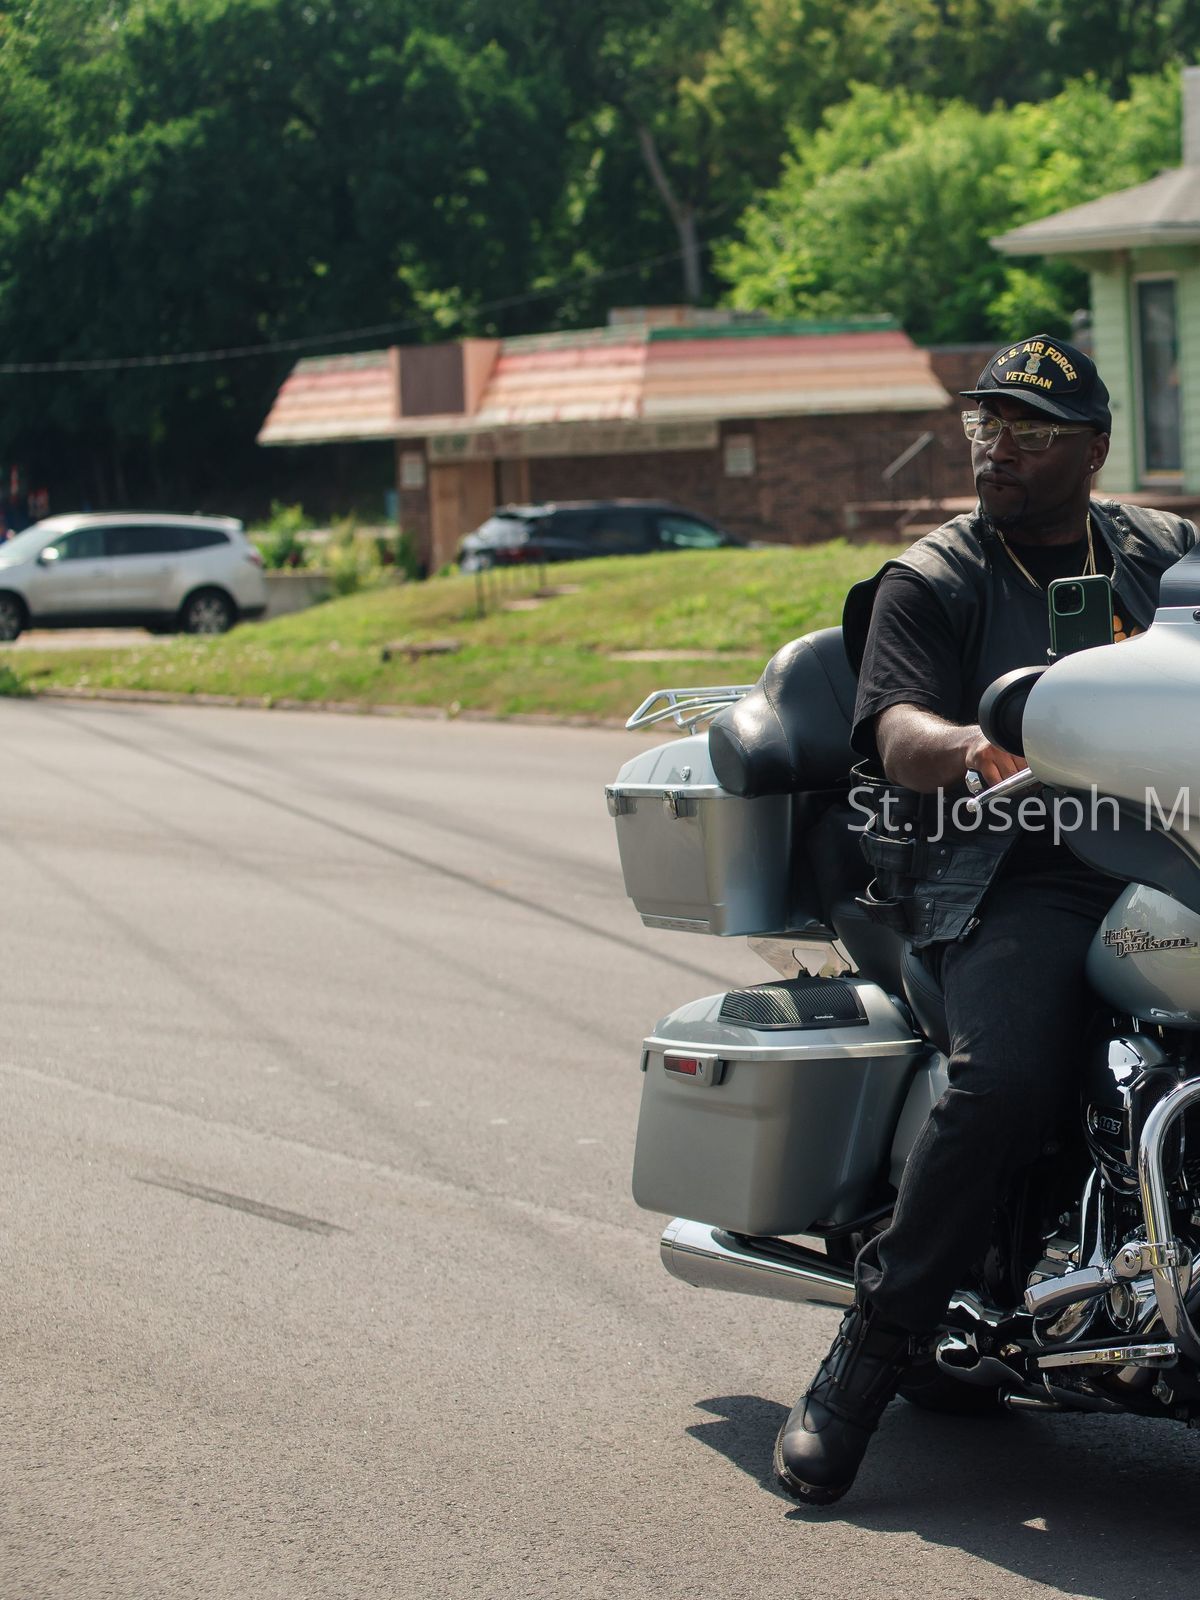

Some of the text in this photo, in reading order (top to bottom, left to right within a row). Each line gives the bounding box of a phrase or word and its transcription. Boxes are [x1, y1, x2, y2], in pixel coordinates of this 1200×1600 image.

[1022, 342, 1044, 354] AIR
[1045, 346, 1078, 381] FORCE
[1005, 371, 1053, 390] VETERAN
[1103, 927, 1148, 946] Harley
[1115, 936, 1197, 957] Davidson
[1100, 1116, 1121, 1134] 103
